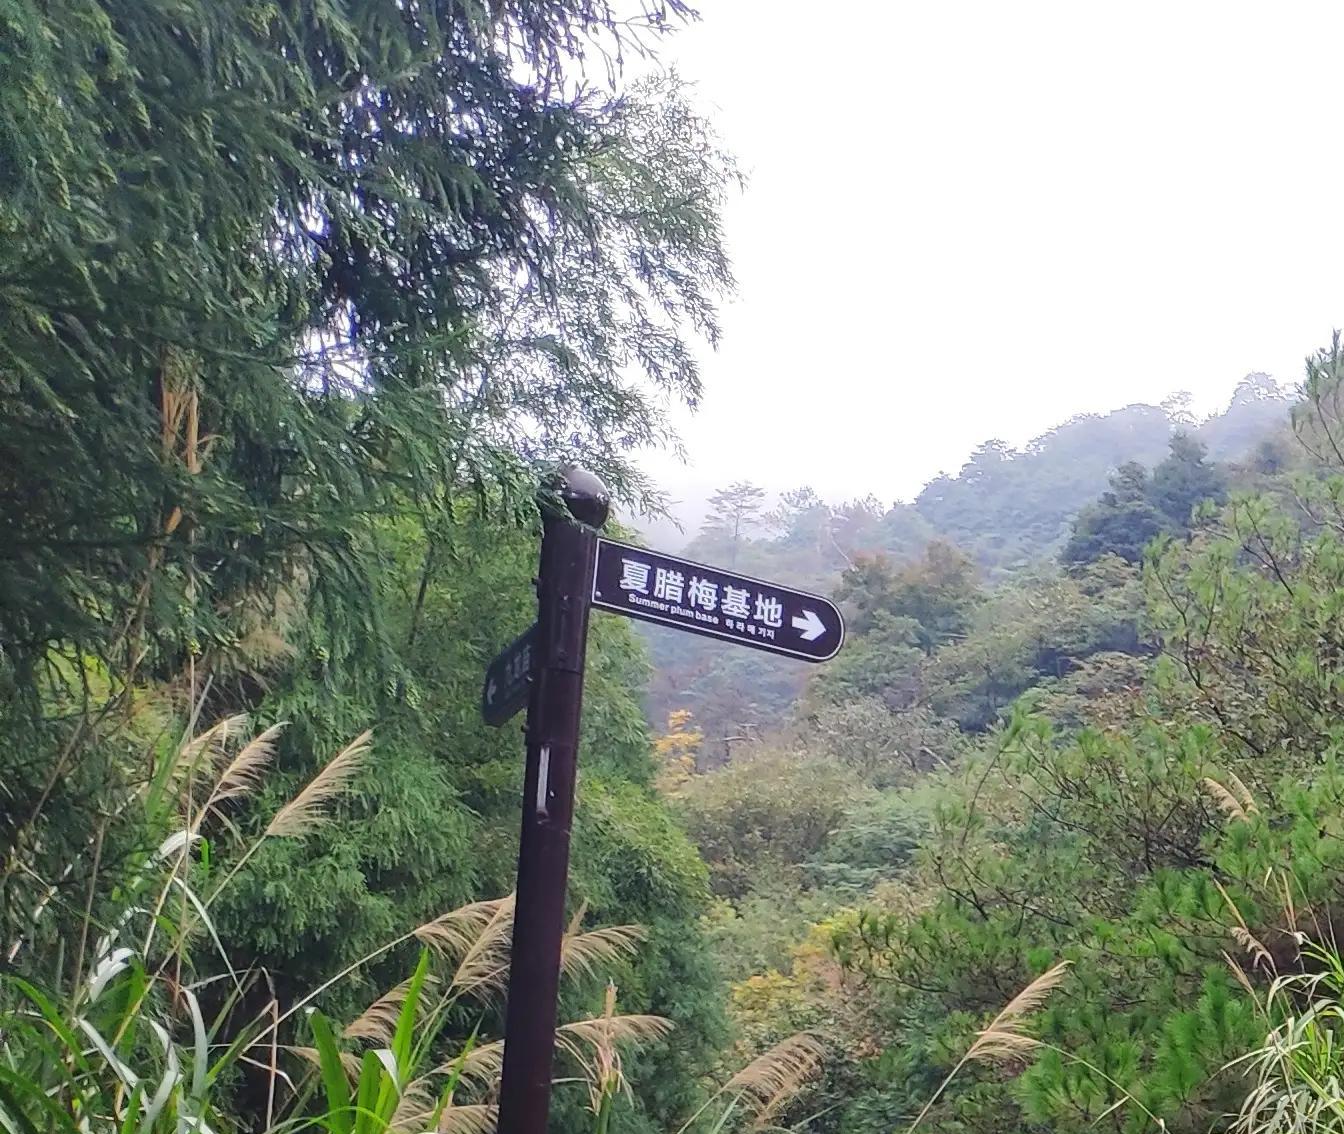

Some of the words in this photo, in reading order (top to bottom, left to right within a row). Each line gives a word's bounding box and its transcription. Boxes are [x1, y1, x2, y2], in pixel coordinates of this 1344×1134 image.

[619, 558, 783, 628] 夏腊梅基地
[628, 593, 669, 612] Summer
[670, 604, 694, 619] plum
[695, 611, 719, 625] base
